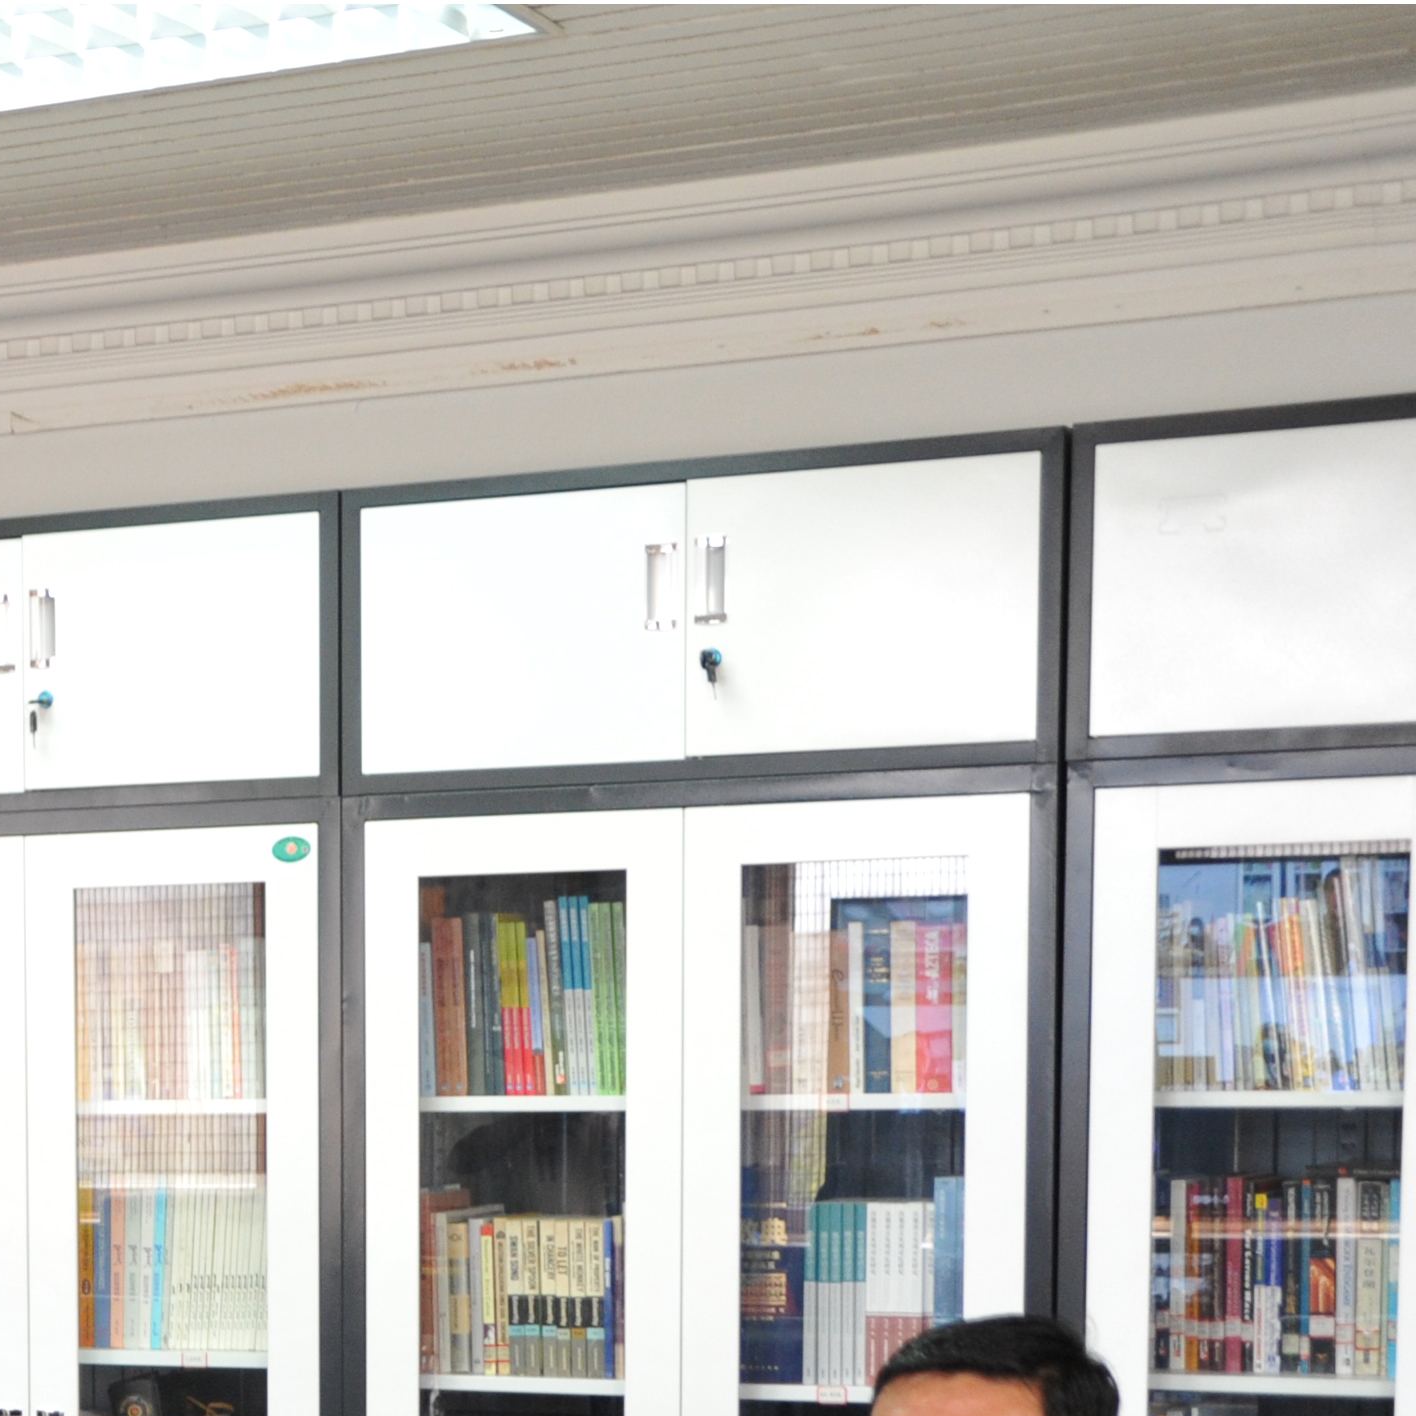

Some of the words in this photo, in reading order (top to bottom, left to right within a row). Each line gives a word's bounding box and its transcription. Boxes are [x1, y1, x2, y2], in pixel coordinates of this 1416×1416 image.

[558, 1246, 567, 1257] TO
[511, 1260, 519, 1280] SONG
[558, 1260, 567, 1275] LET
